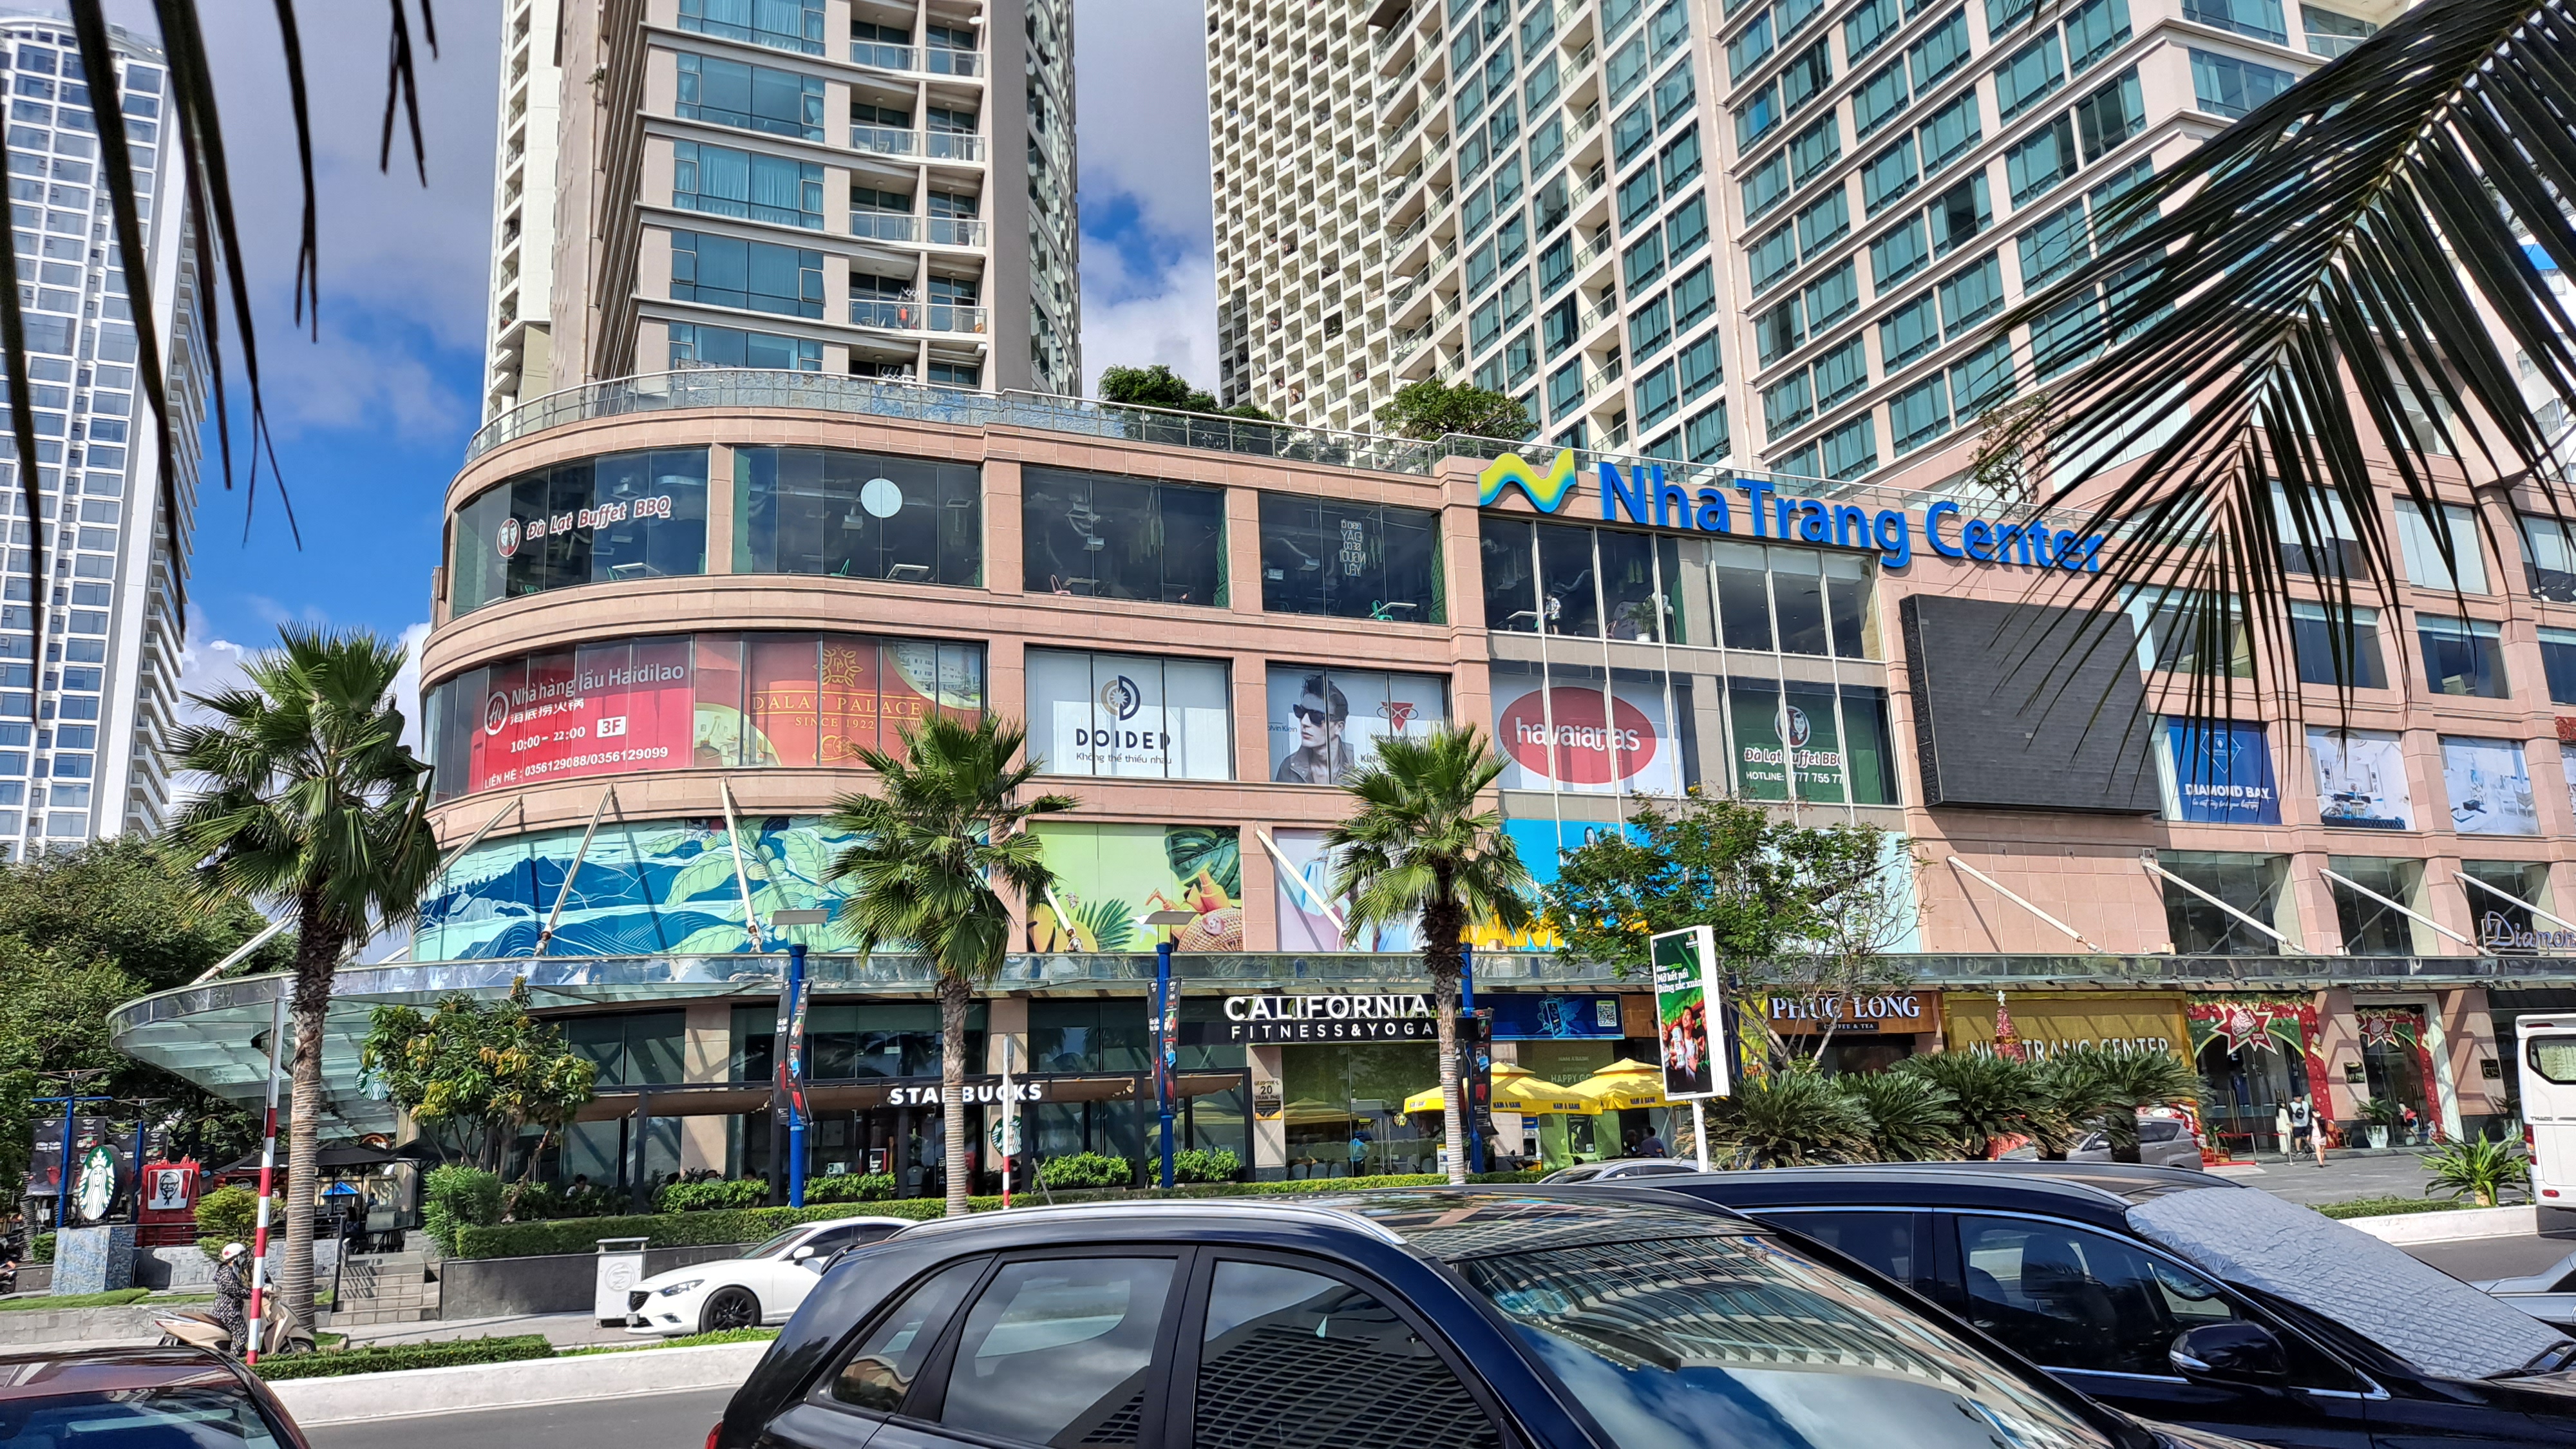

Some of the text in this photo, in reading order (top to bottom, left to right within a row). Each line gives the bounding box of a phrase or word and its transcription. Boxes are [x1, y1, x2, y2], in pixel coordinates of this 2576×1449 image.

[527, 495, 671, 540] Đà Lạt Buffet BBQ
[1598, 461, 2106, 573] Nha Trang Center
[511, 663, 685, 707] Nhà hàng lẩu Haidilao
[509, 697, 585, 726] 海底捞火锅
[752, 695, 922, 716] DALA PALACE
[795, 716, 875, 730] SINCE 1922
[1515, 716, 1640, 752] havaianas
[510, 734, 540, 753] 10:00
[553, 726, 586, 742] 22:00
[601, 717, 621, 734] 3F
[484, 772, 502, 790] LIÊN
[504, 770, 516, 785] HỆ
[525, 746, 669, 777] 0356129088/0356129099
[1125, 753, 1147, 763] thiếu
[1745, 748, 1761, 762] Đà
[1763, 748, 1782, 766] Lạt
[1785, 750, 1821, 768] uffet
[1746, 771, 1785, 781] HOTLINE:
[1811, 773, 1830, 783] 755
[2246, 786, 2269, 799] BAY
[1224, 994, 1431, 1021] CALIFORNIA
[1853, 996, 1920, 1018] LONG
[1551, 1074, 1577, 1083] HAPPY
[890, 1083, 1042, 1105] STABUCKS
[1260, 1085, 1273, 1095] 20
